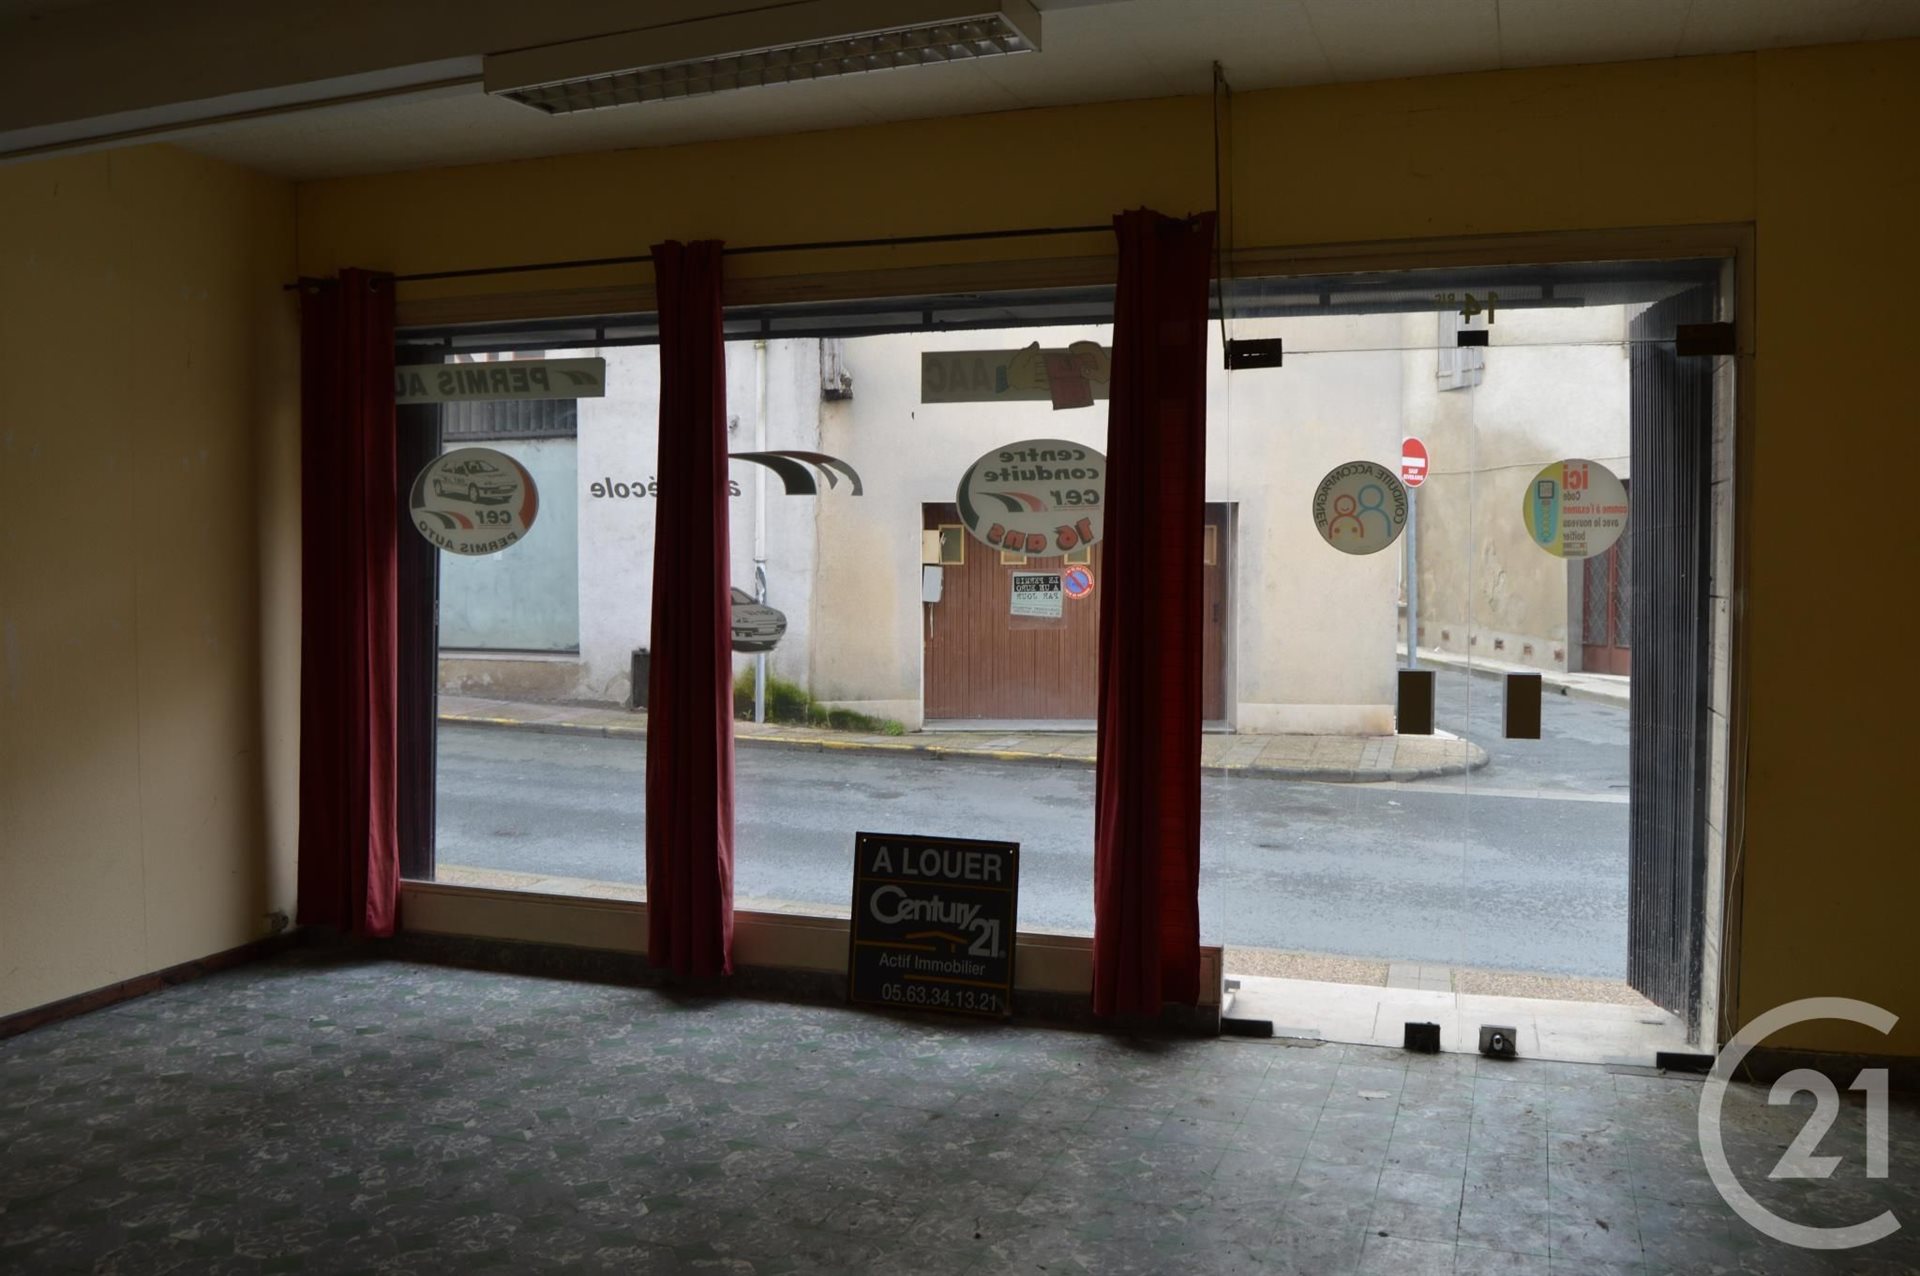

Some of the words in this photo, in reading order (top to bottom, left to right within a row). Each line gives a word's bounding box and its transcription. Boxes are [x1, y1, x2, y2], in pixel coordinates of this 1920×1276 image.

[872, 846, 893, 873] A
[902, 848, 1002, 881] LOUER
[870, 885, 982, 930] Century
[967, 917, 1000, 957] 21
[879, 952, 911, 968] Actif
[914, 956, 986, 976] Immobilier
[881, 983, 997, 1011] 05.63.34.13.21
